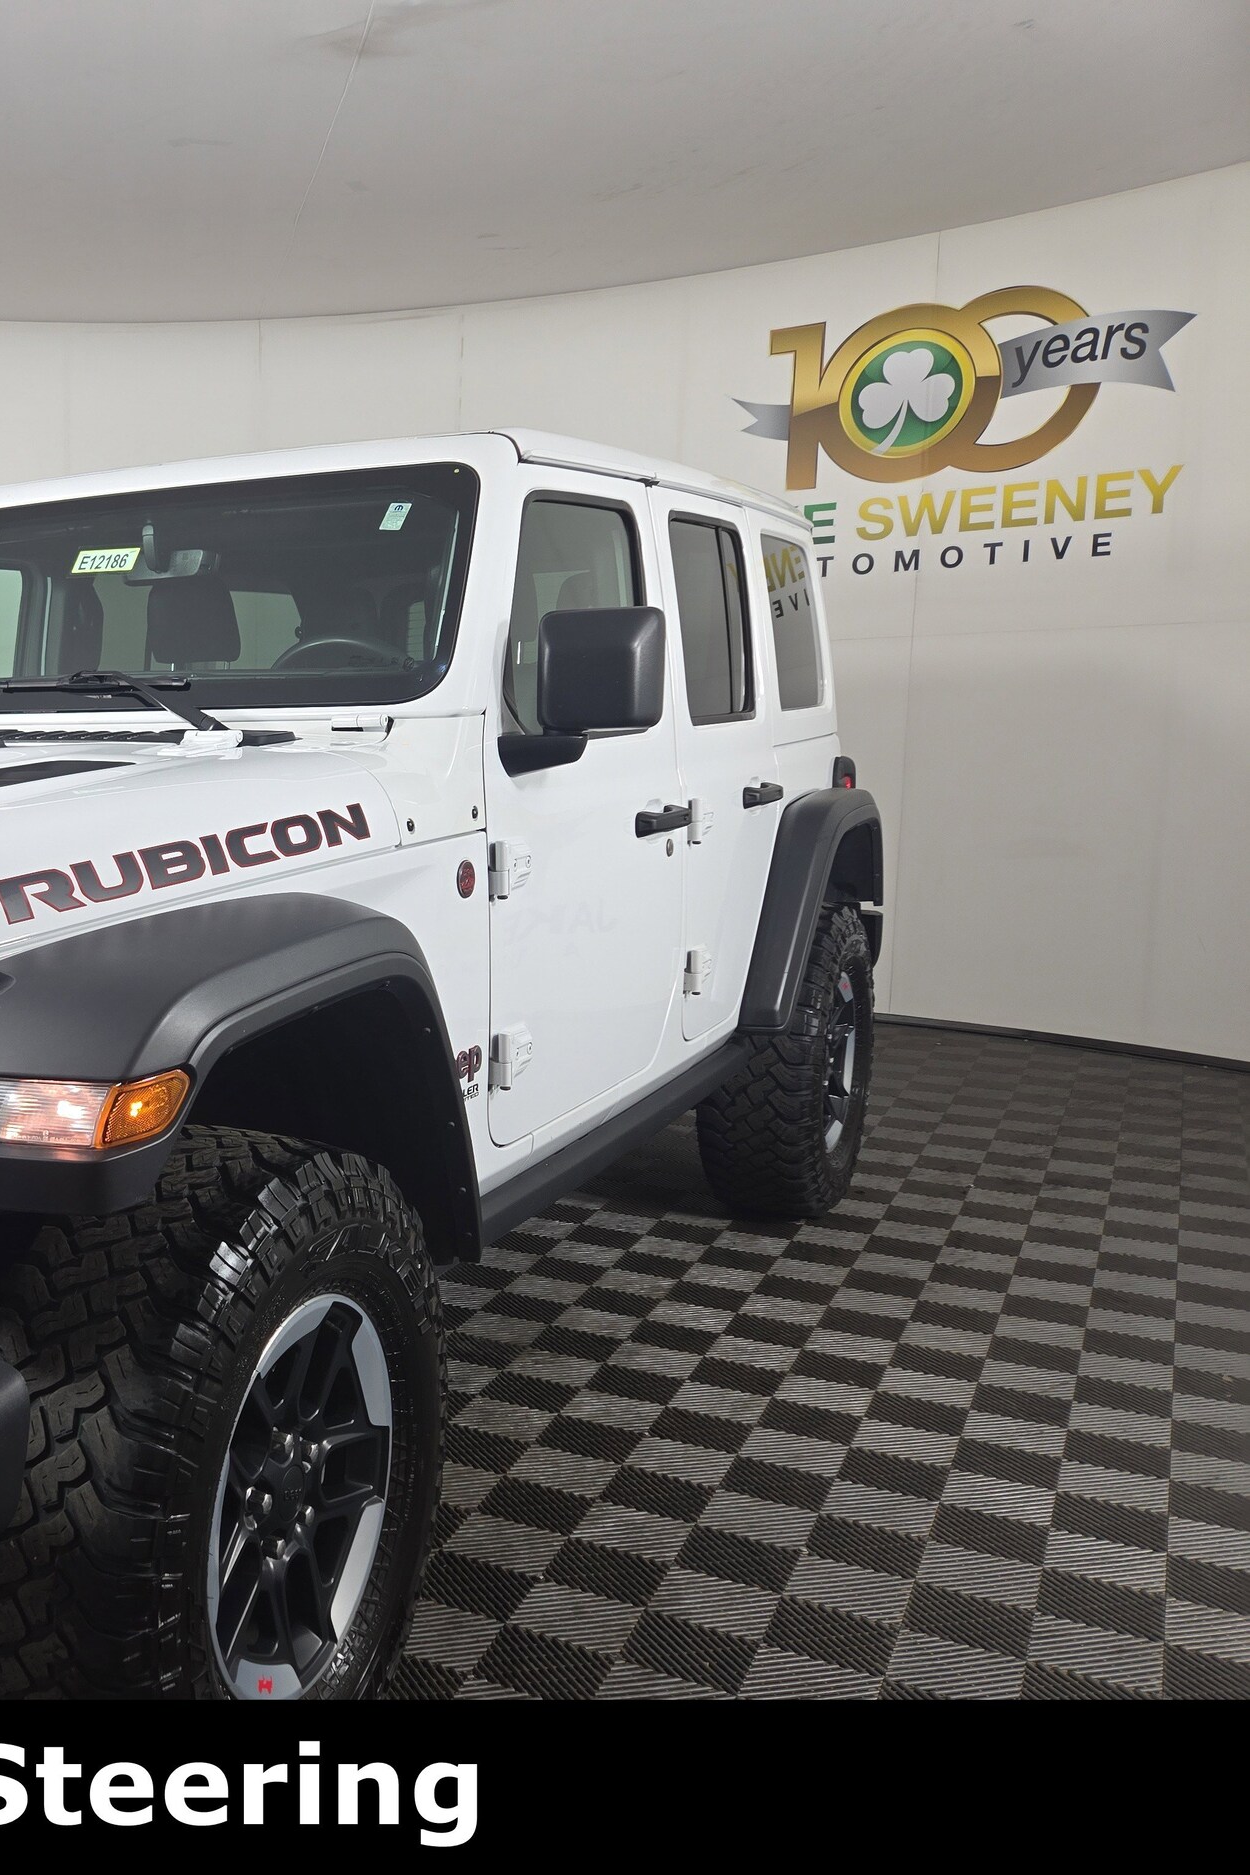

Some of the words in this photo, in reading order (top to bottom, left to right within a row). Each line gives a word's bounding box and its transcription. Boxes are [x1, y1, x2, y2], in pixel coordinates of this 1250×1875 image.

[1012, 322, 1149, 389] years
[855, 464, 1184, 541] SWEENEY
[78, 553, 129, 571] E12186
[816, 532, 1112, 578] TOMOTIVE
[456, 1045, 482, 1083] ep
